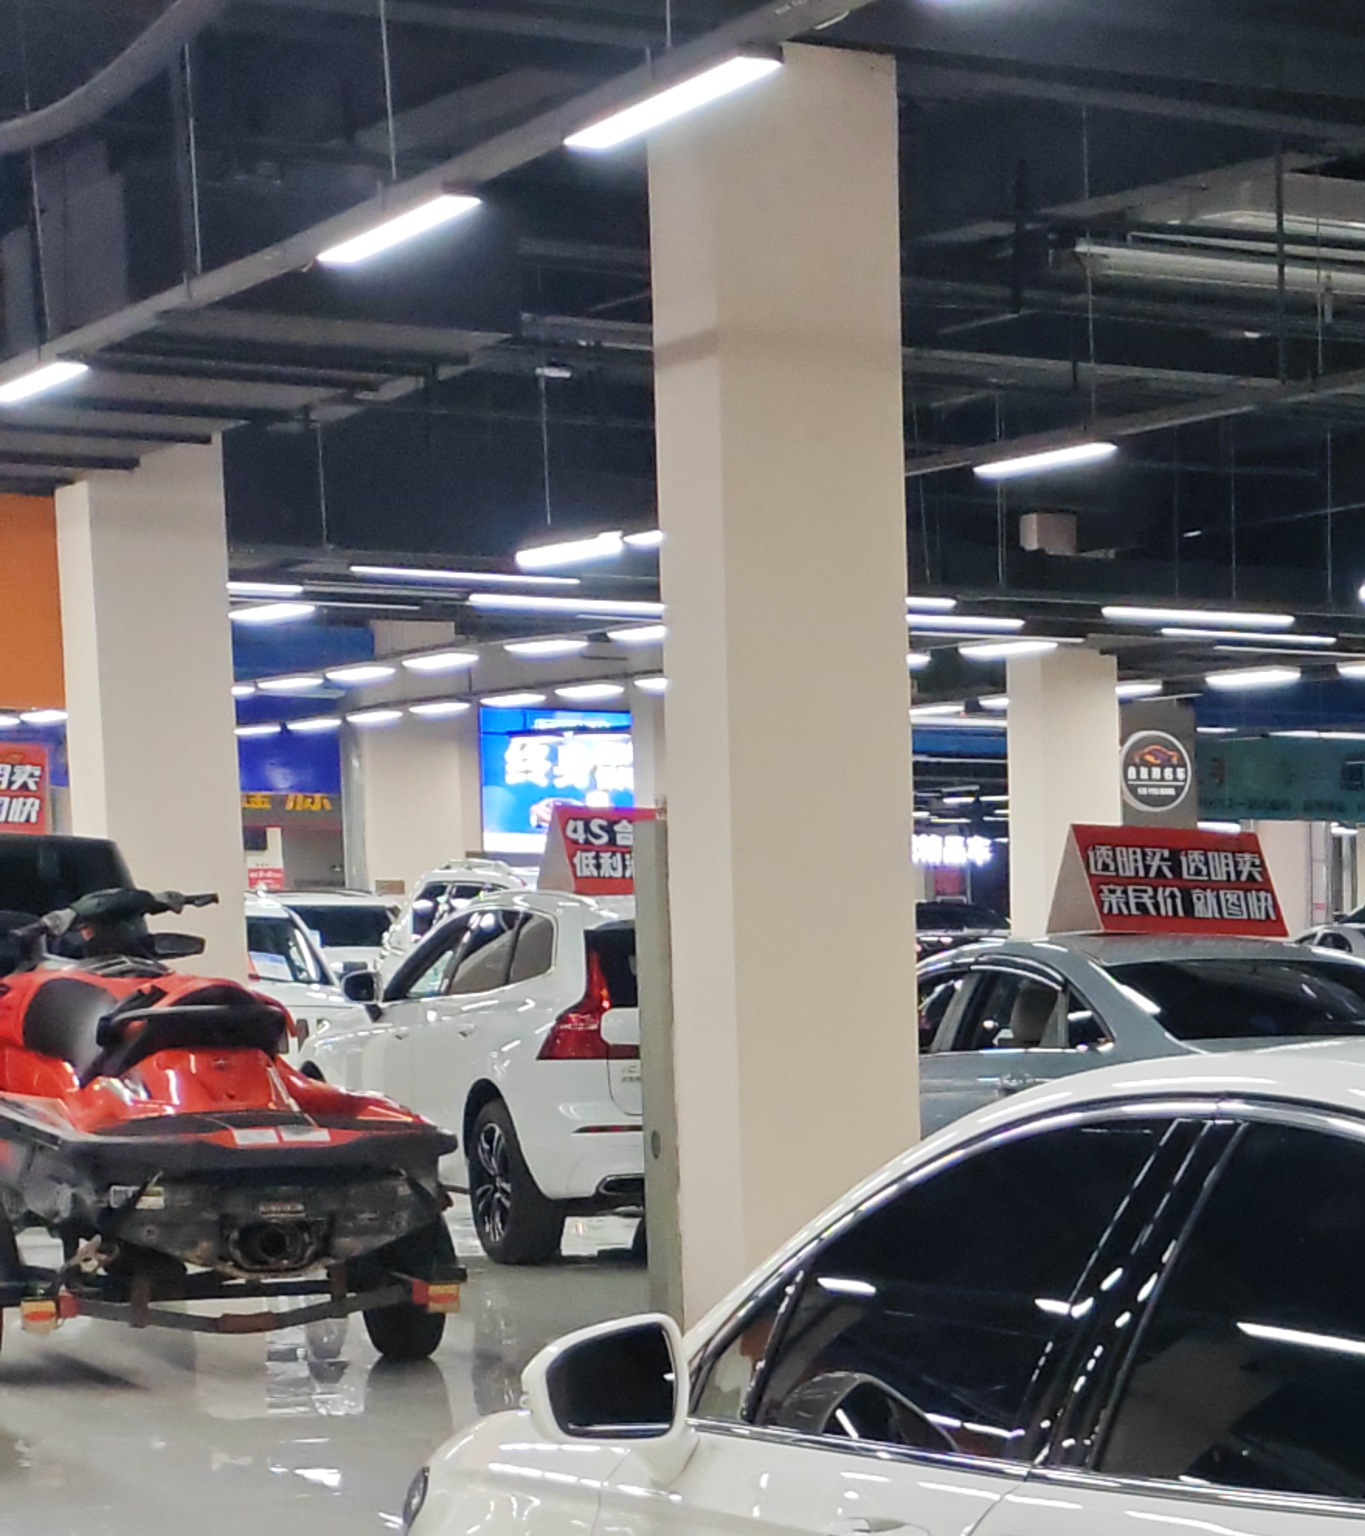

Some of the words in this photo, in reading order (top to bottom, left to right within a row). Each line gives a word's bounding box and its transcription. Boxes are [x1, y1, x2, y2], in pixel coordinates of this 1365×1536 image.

[1088, 845, 1173, 878] 透明买
[1180, 851, 1263, 882] 透明卖
[1099, 884, 1184, 917] 亲民价
[1191, 889, 1277, 921] 就图快
